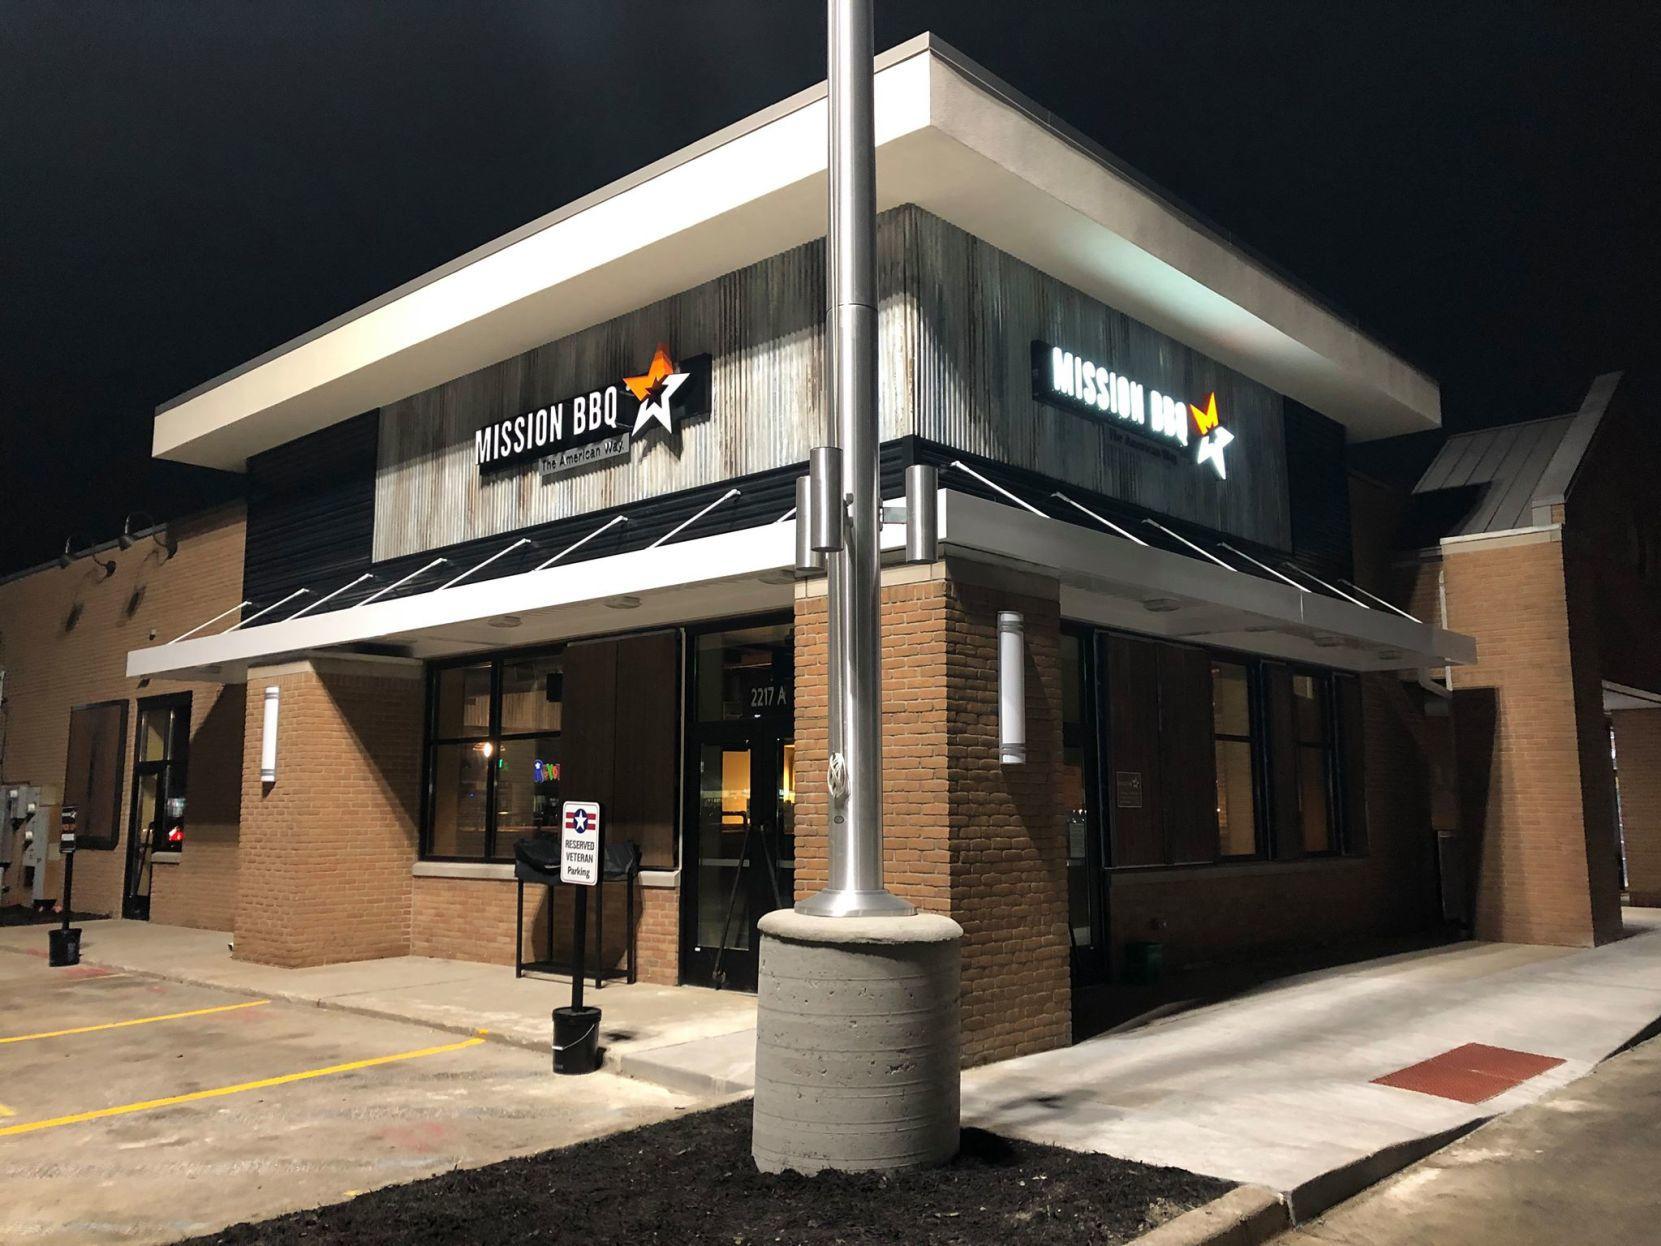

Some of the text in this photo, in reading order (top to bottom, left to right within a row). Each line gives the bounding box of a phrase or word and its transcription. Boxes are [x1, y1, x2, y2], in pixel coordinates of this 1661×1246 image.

[1052, 346, 1145, 425] MISSION
[475, 386, 618, 464] MISSION BBQ
[542, 459, 557, 472] The
[560, 446, 601, 466] American
[751, 685, 787, 706] 2217 A
[565, 839, 595, 851] RESERVED
[566, 852, 593, 863] VETERAN
[567, 866, 590, 879] Parking
